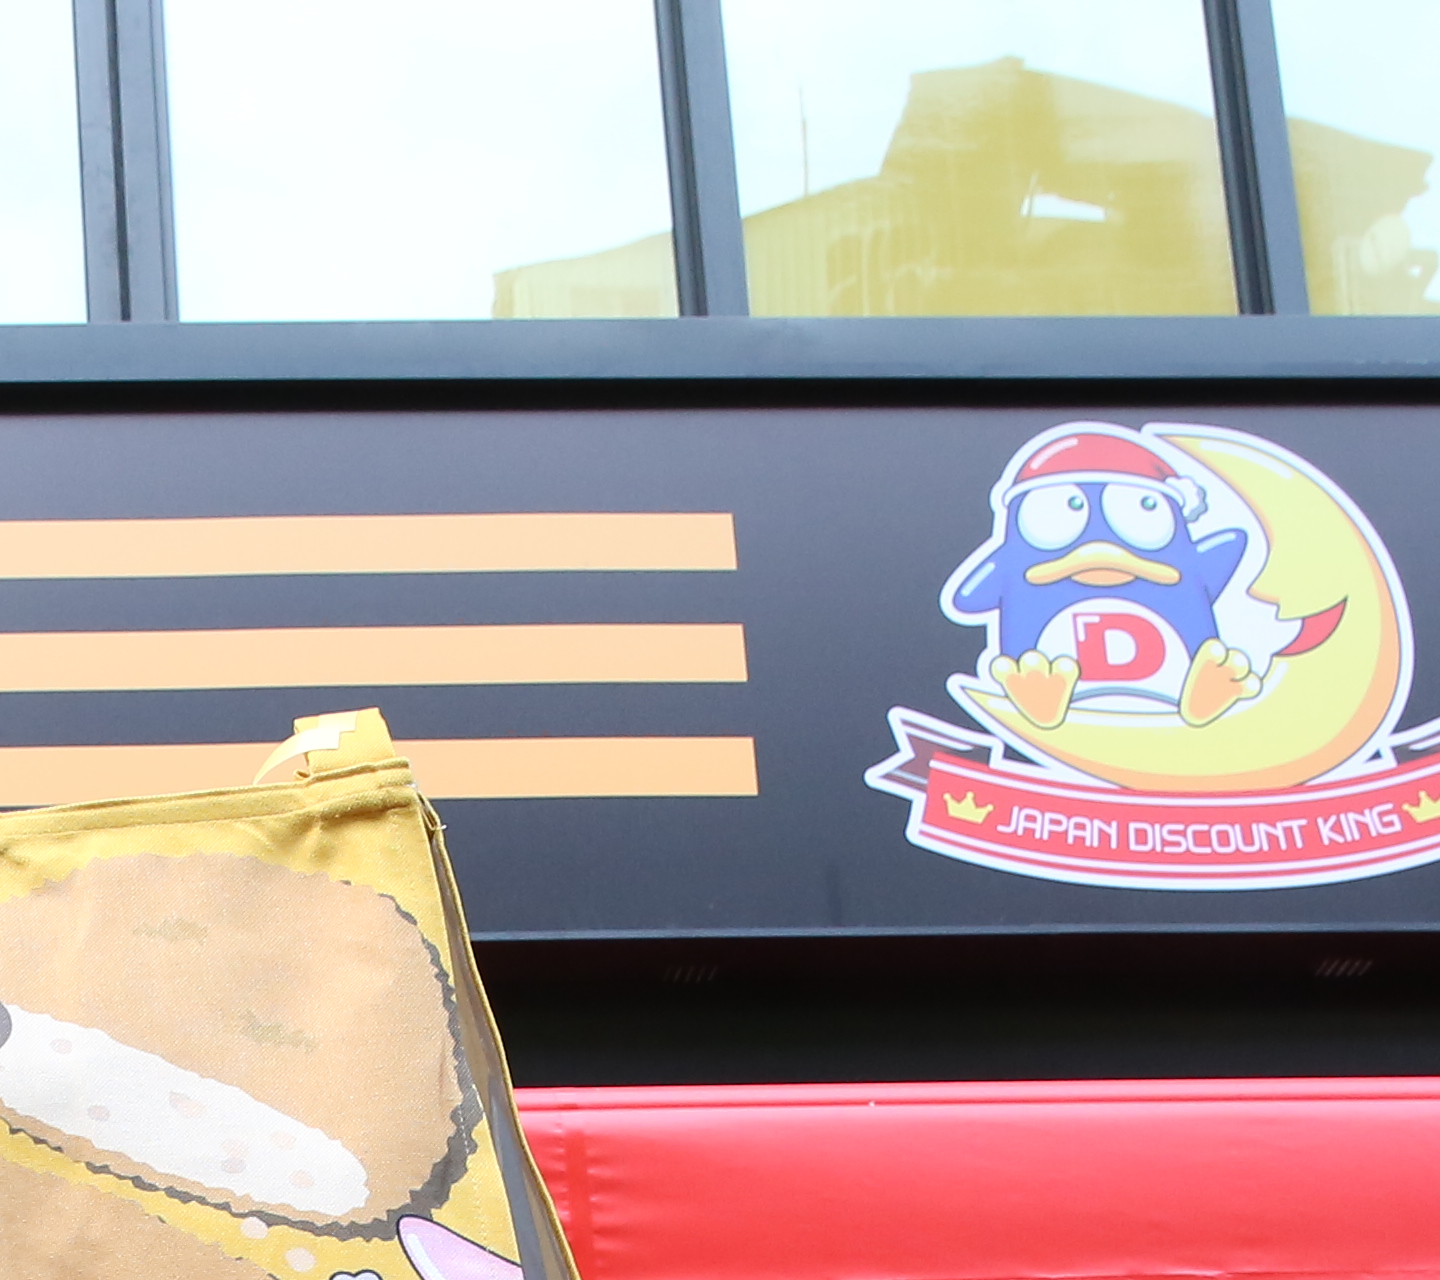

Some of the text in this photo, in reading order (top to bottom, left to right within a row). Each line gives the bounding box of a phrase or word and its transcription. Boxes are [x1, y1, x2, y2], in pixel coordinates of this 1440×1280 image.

[997, 803, 1404, 854] JAPAN DISCOUNT KING
